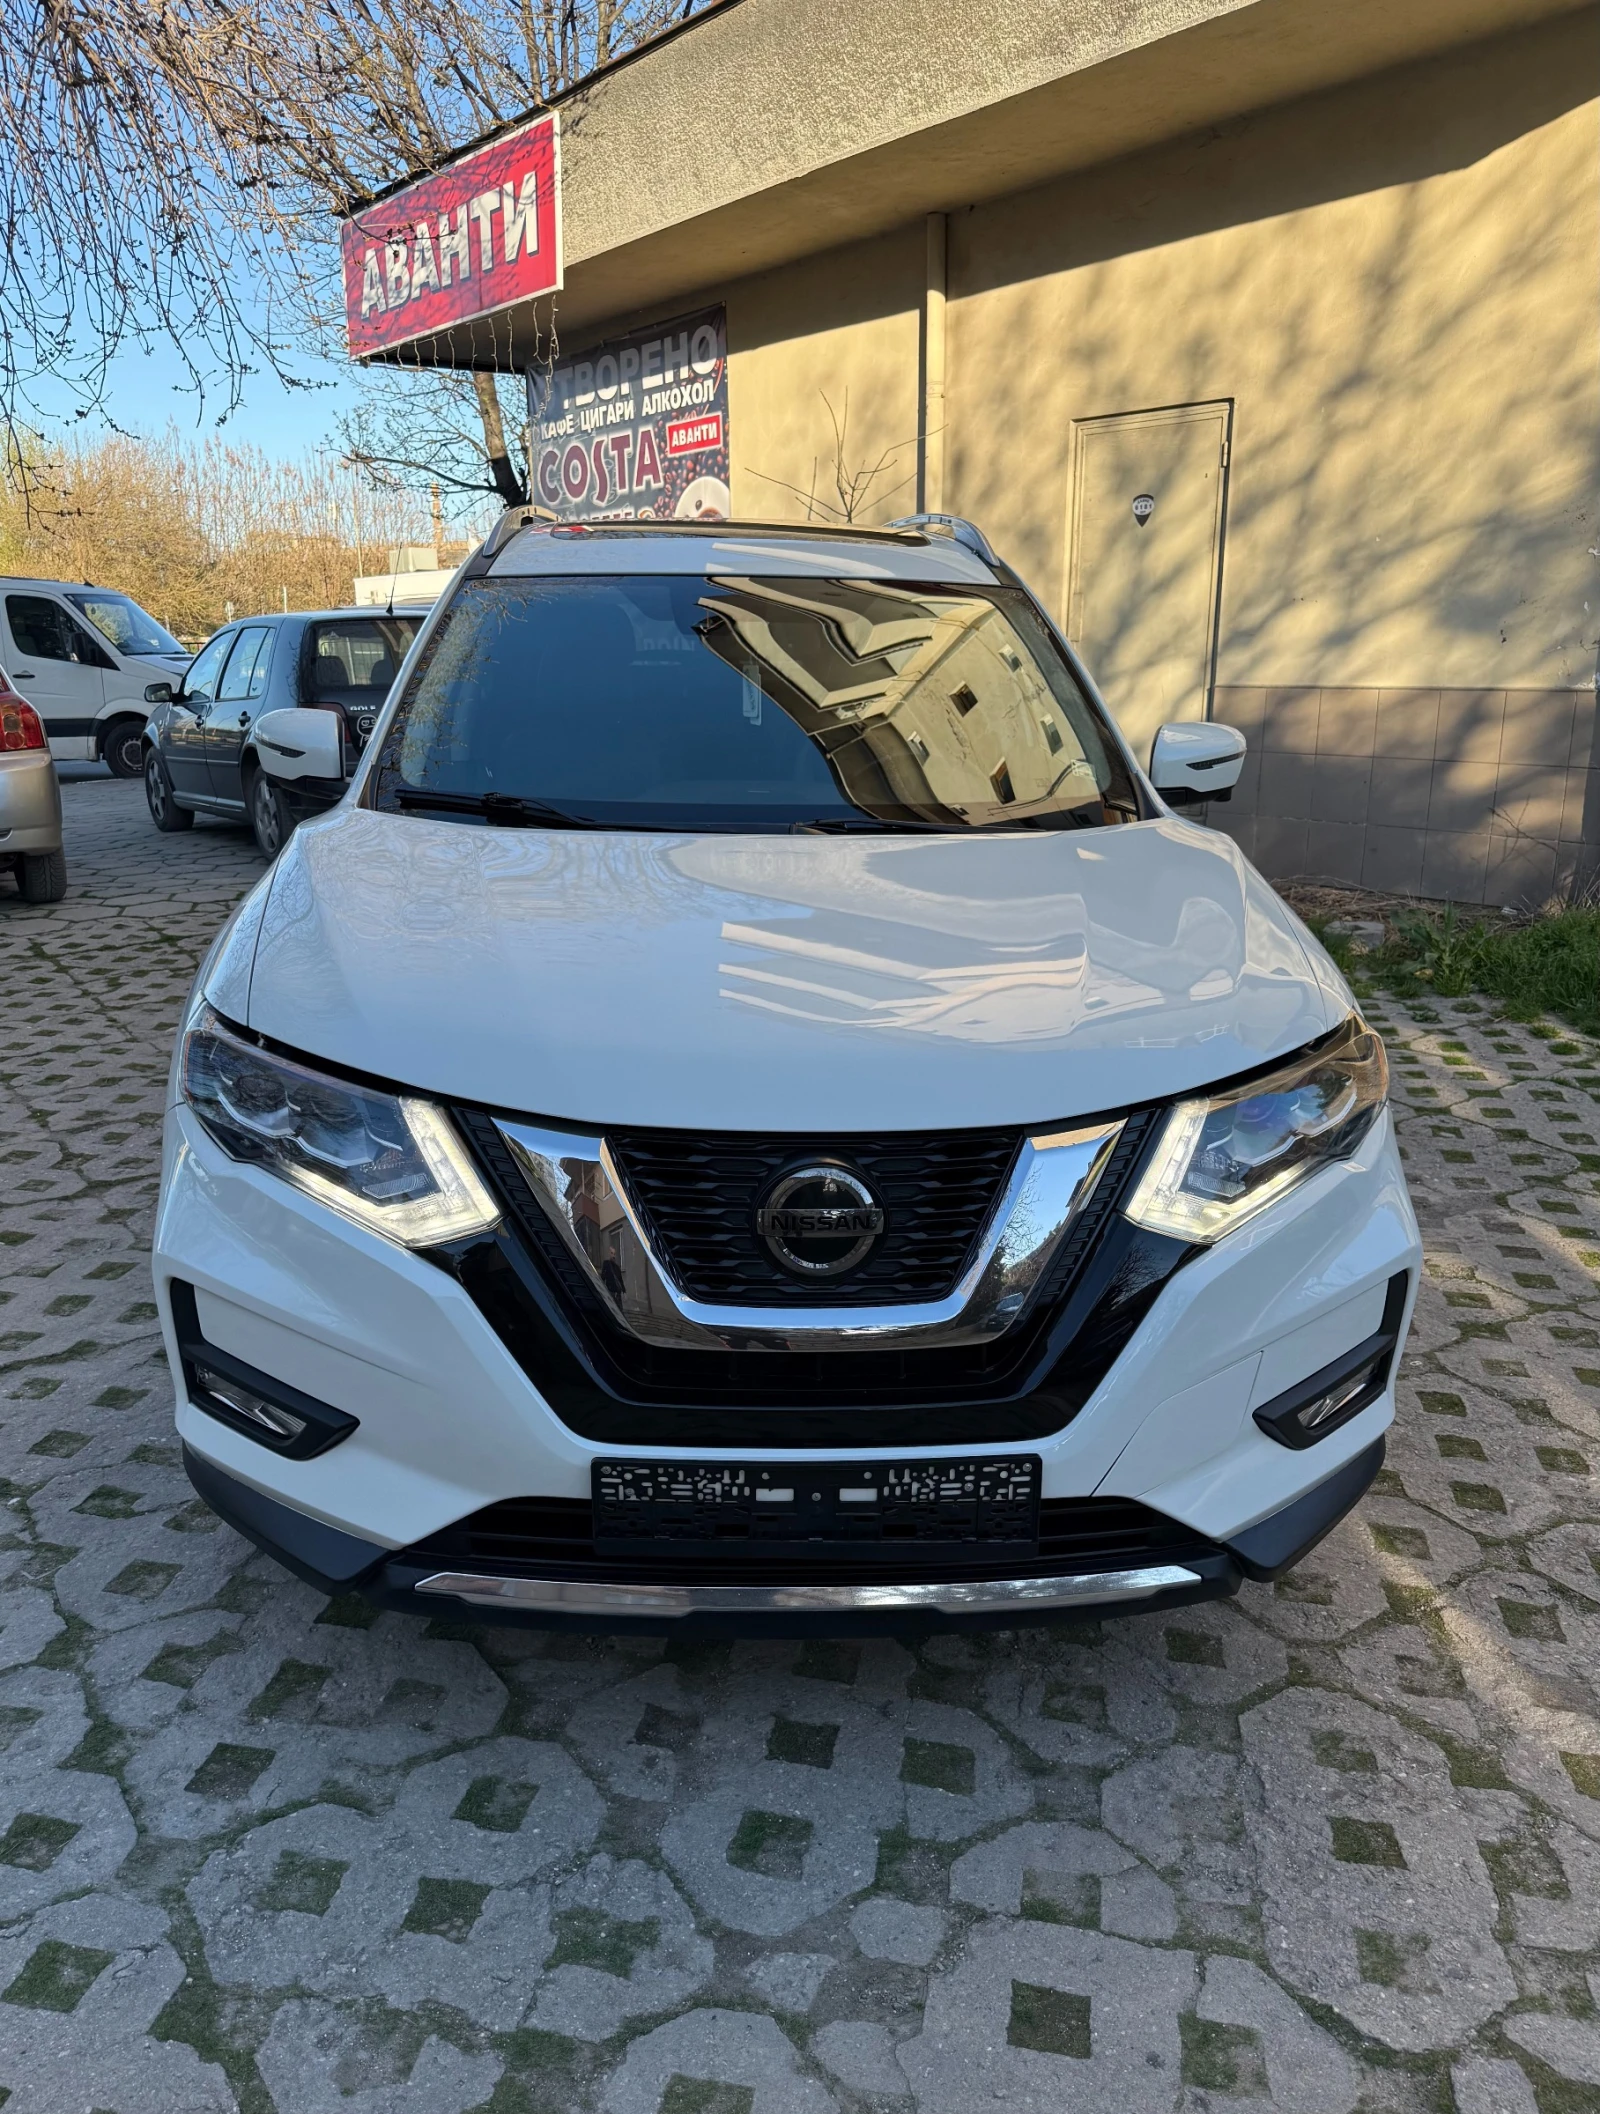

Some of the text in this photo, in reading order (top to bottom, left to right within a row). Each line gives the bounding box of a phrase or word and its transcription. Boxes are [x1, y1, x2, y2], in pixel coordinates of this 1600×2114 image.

[361, 171, 538, 319] АВАНТИ
[552, 324, 718, 409] ТВОРЕНО
[541, 379, 715, 440] КАФЕ ЦИГАРИ АЛКОХОЛ
[671, 422, 718, 447] АВАНТИ
[539, 427, 664, 504] COSTA
[771, 1215, 871, 1231] NISSAN
